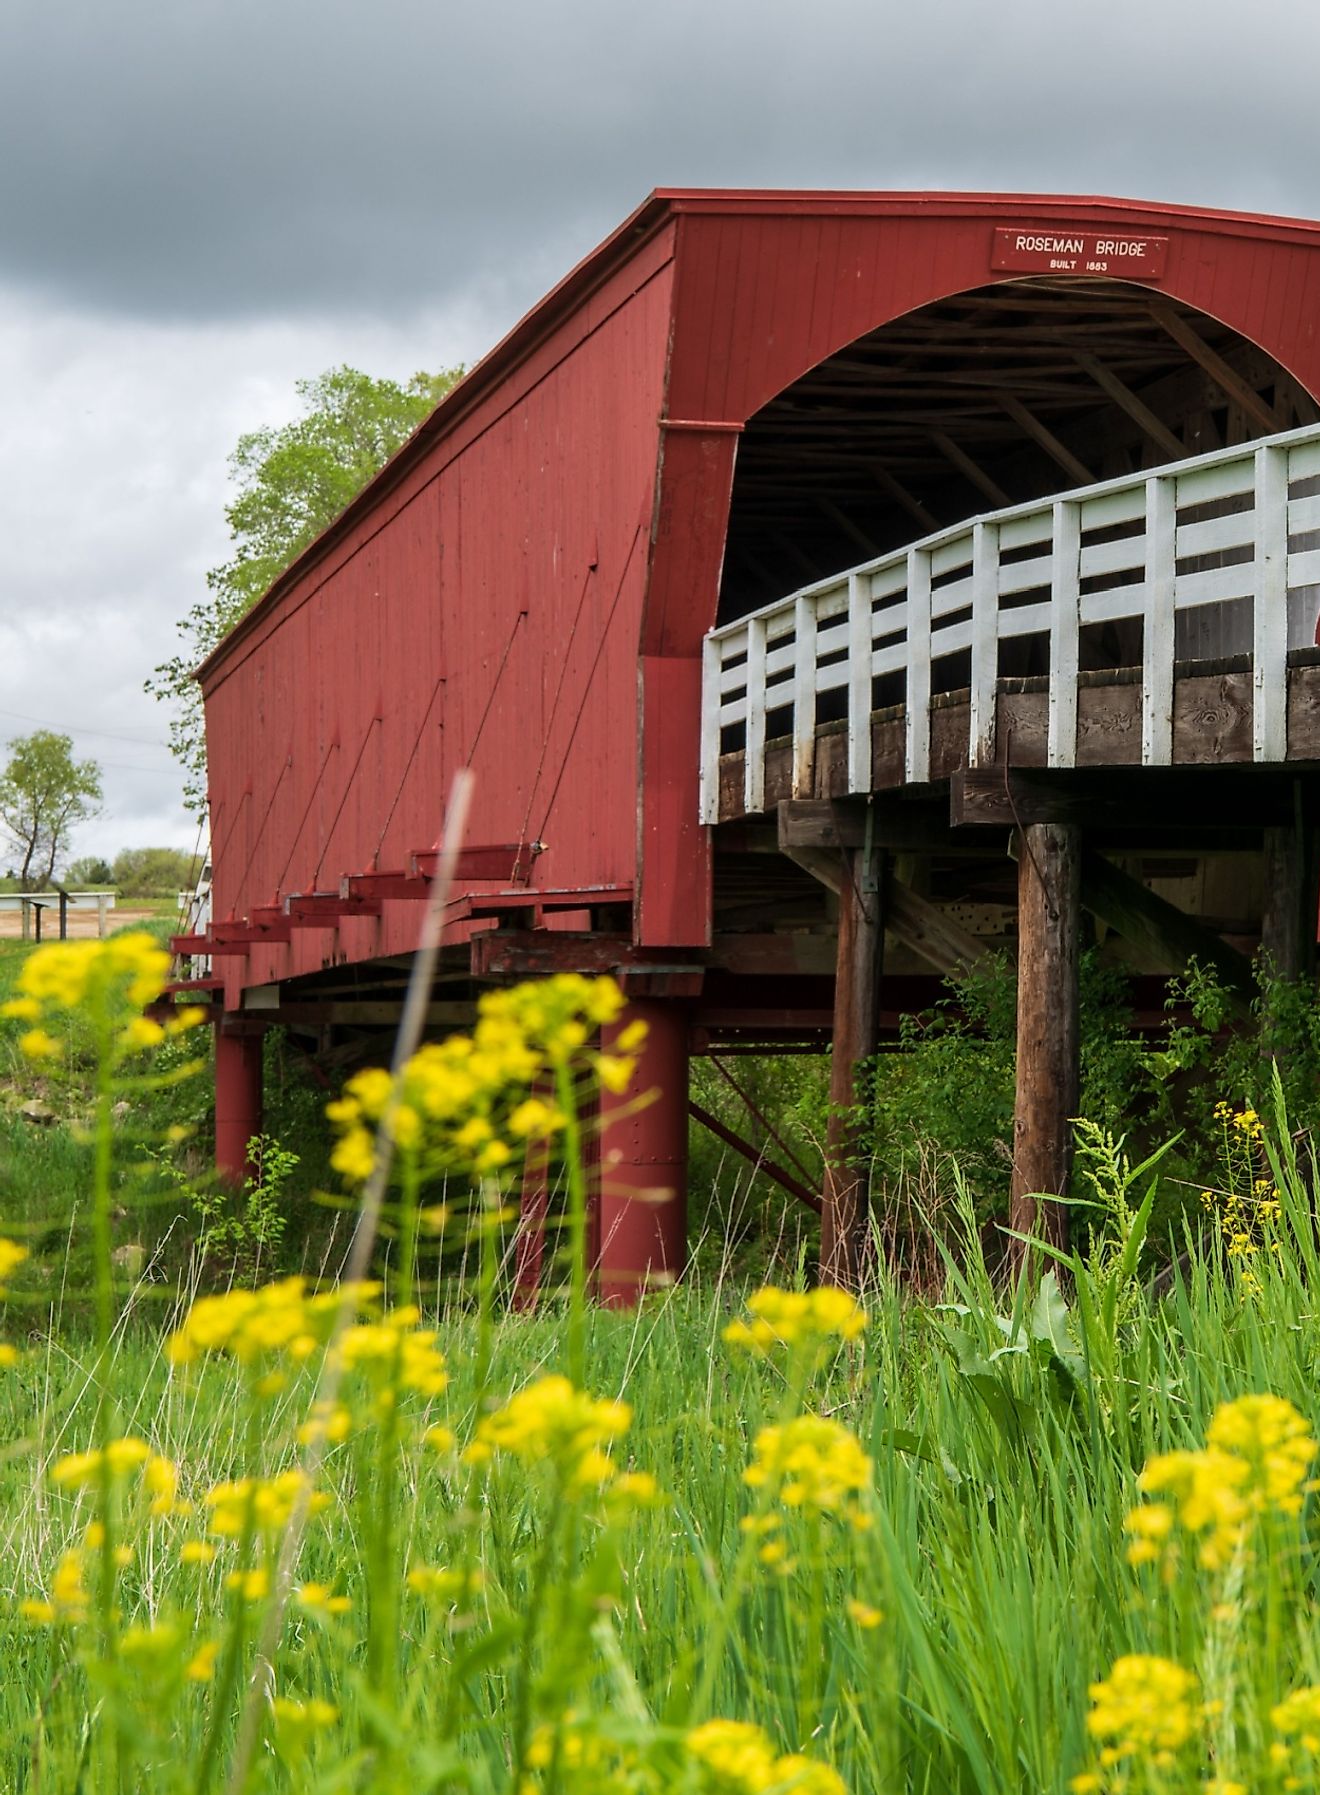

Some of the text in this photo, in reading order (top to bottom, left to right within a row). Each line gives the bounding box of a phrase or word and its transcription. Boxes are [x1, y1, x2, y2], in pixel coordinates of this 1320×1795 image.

[1016, 236, 1147, 257] ROSEMAN BRIDGE
[1050, 259, 1107, 271] BUILT 1883
